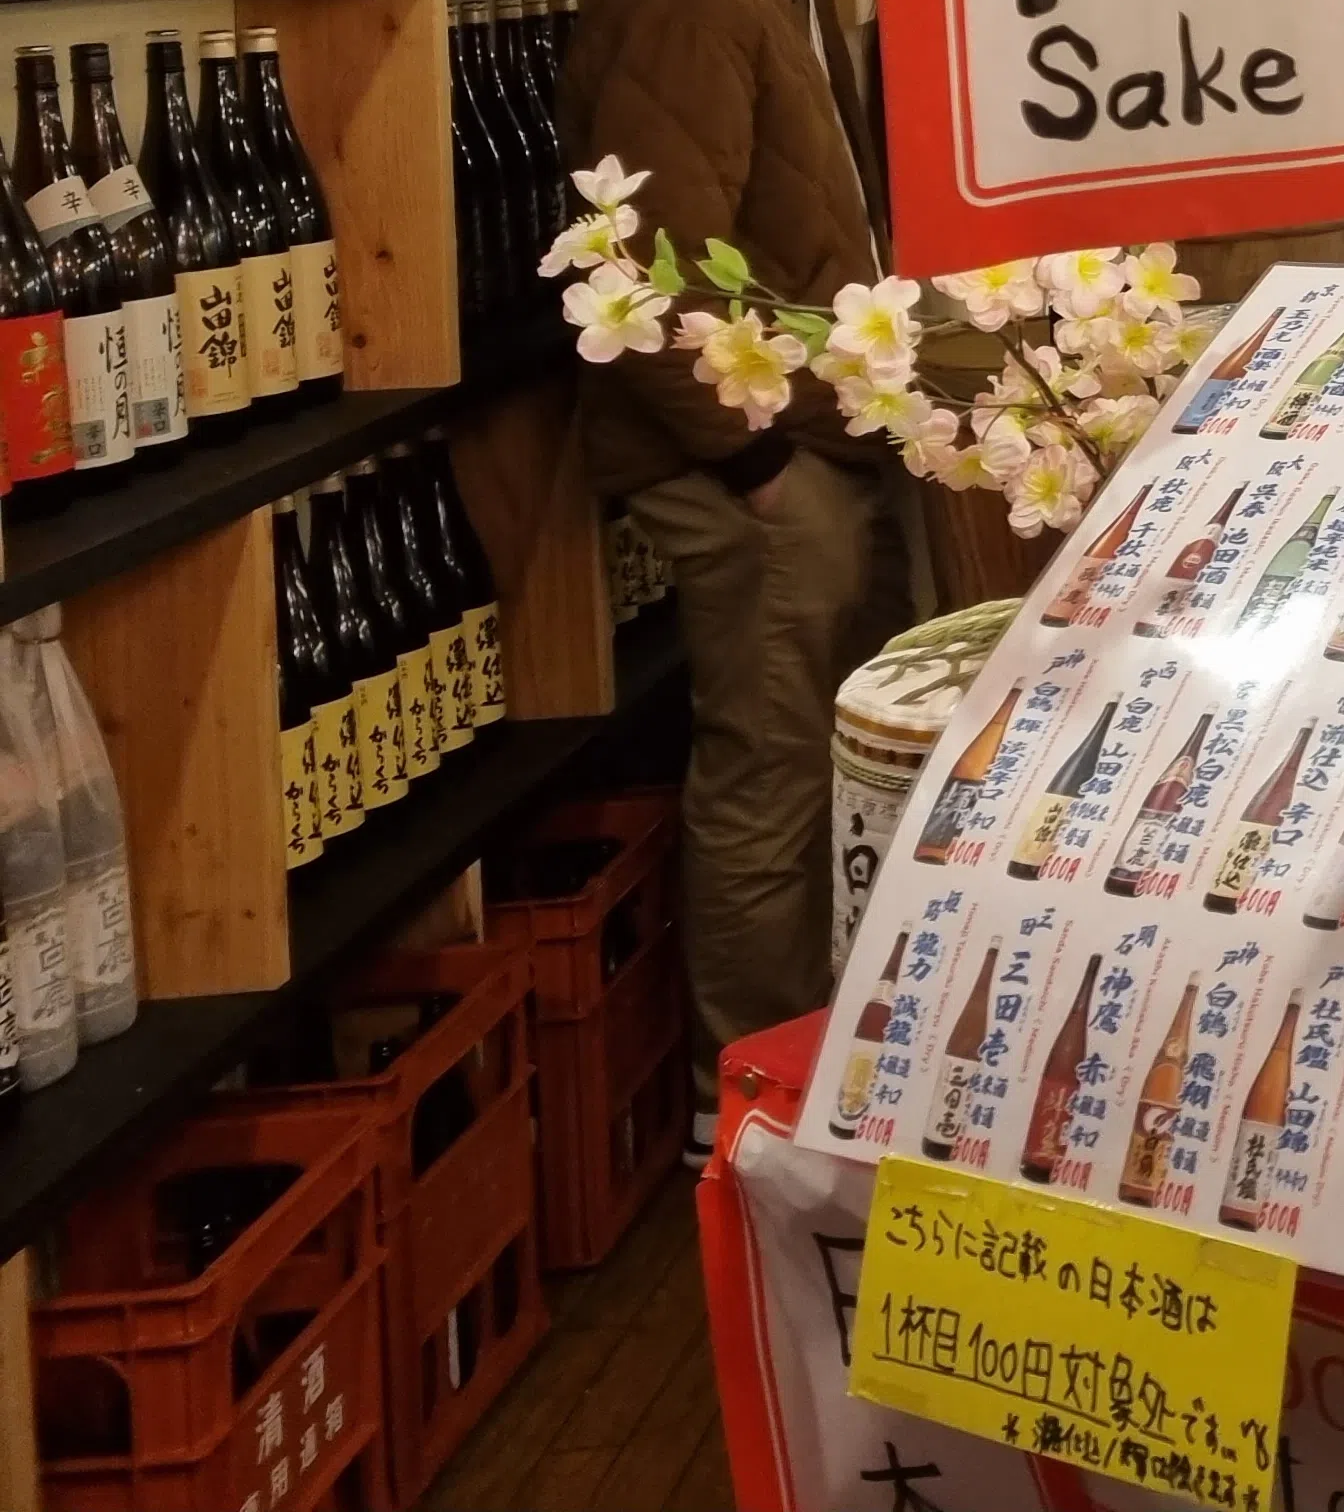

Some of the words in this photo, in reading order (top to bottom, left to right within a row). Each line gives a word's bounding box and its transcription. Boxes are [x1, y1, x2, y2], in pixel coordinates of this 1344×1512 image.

[1020, 12, 1304, 142] Sake
[199, 284, 238, 378] 山田錦
[98, 325, 129, 439] 恒の月
[1147, 477, 1188, 513] 秋鹿
[1201, 527, 1250, 584] 池田酒
[1113, 697, 1152, 732] 白鹿
[1080, 742, 1128, 796] 山田錦
[1180, 708, 1248, 807] 黒松白鹿
[1272, 802, 1314, 846] 辛口
[978, 951, 1032, 1067] 三田壱
[1198, 983, 1238, 1038] 白鶴
[1076, 1053, 1109, 1086] 赤
